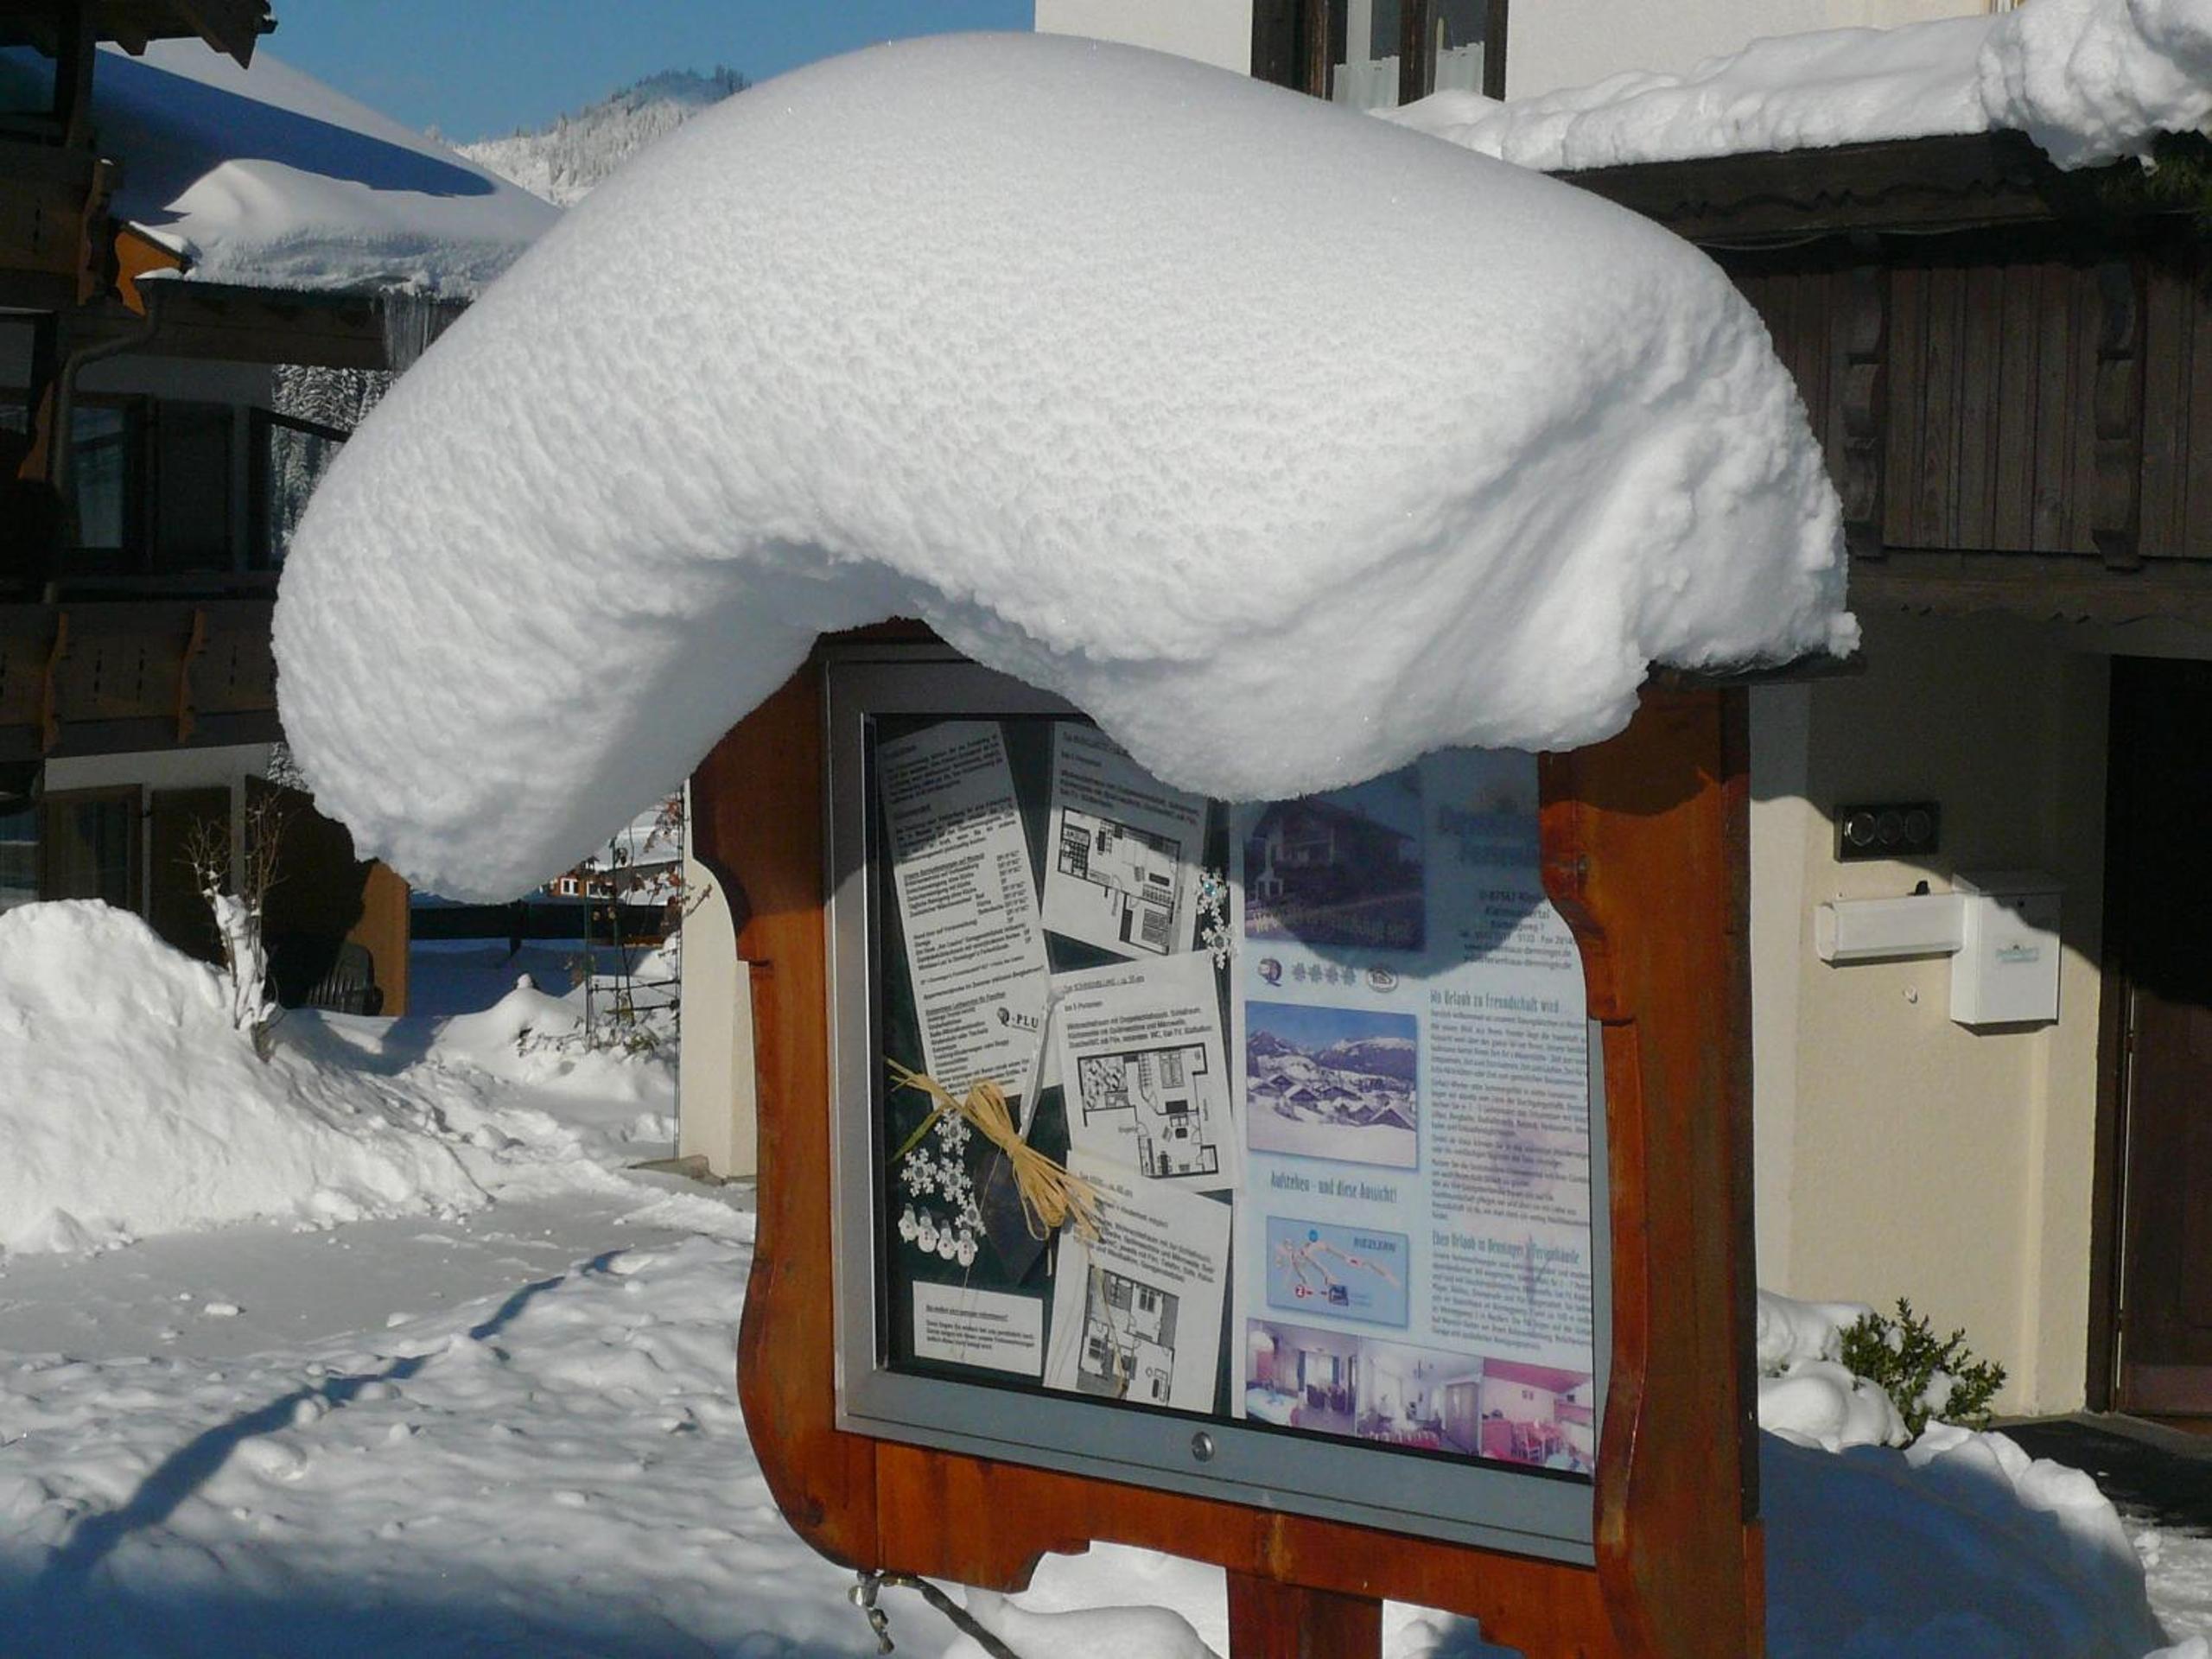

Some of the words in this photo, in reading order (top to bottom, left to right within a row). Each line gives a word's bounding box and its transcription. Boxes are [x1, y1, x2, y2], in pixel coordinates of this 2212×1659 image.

[1445, 989, 1471, 1007] Urlaub
[1271, 1170, 1310, 1192] Aufstehen
[1319, 1179, 1334, 1195] und
[1337, 1179, 1357, 1198] diese
